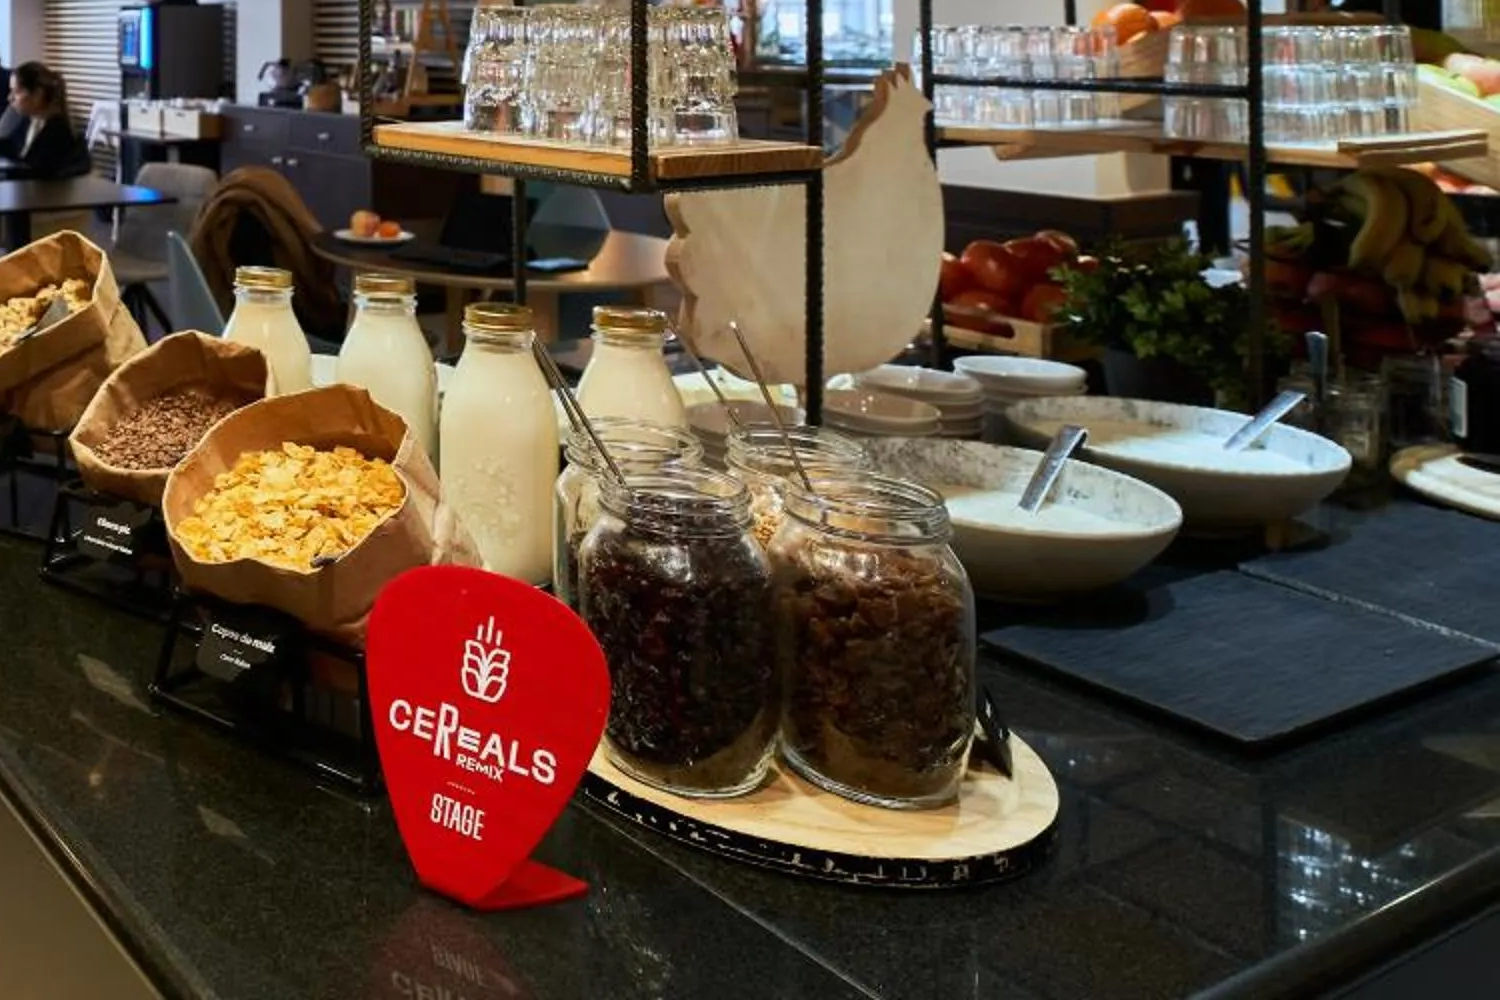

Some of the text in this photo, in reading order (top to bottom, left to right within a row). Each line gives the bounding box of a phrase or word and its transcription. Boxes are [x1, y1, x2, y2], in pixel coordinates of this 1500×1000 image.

[389, 700, 557, 784] CEREALS
[456, 754, 504, 782] REMIX
[430, 793, 485, 841] STAGE
